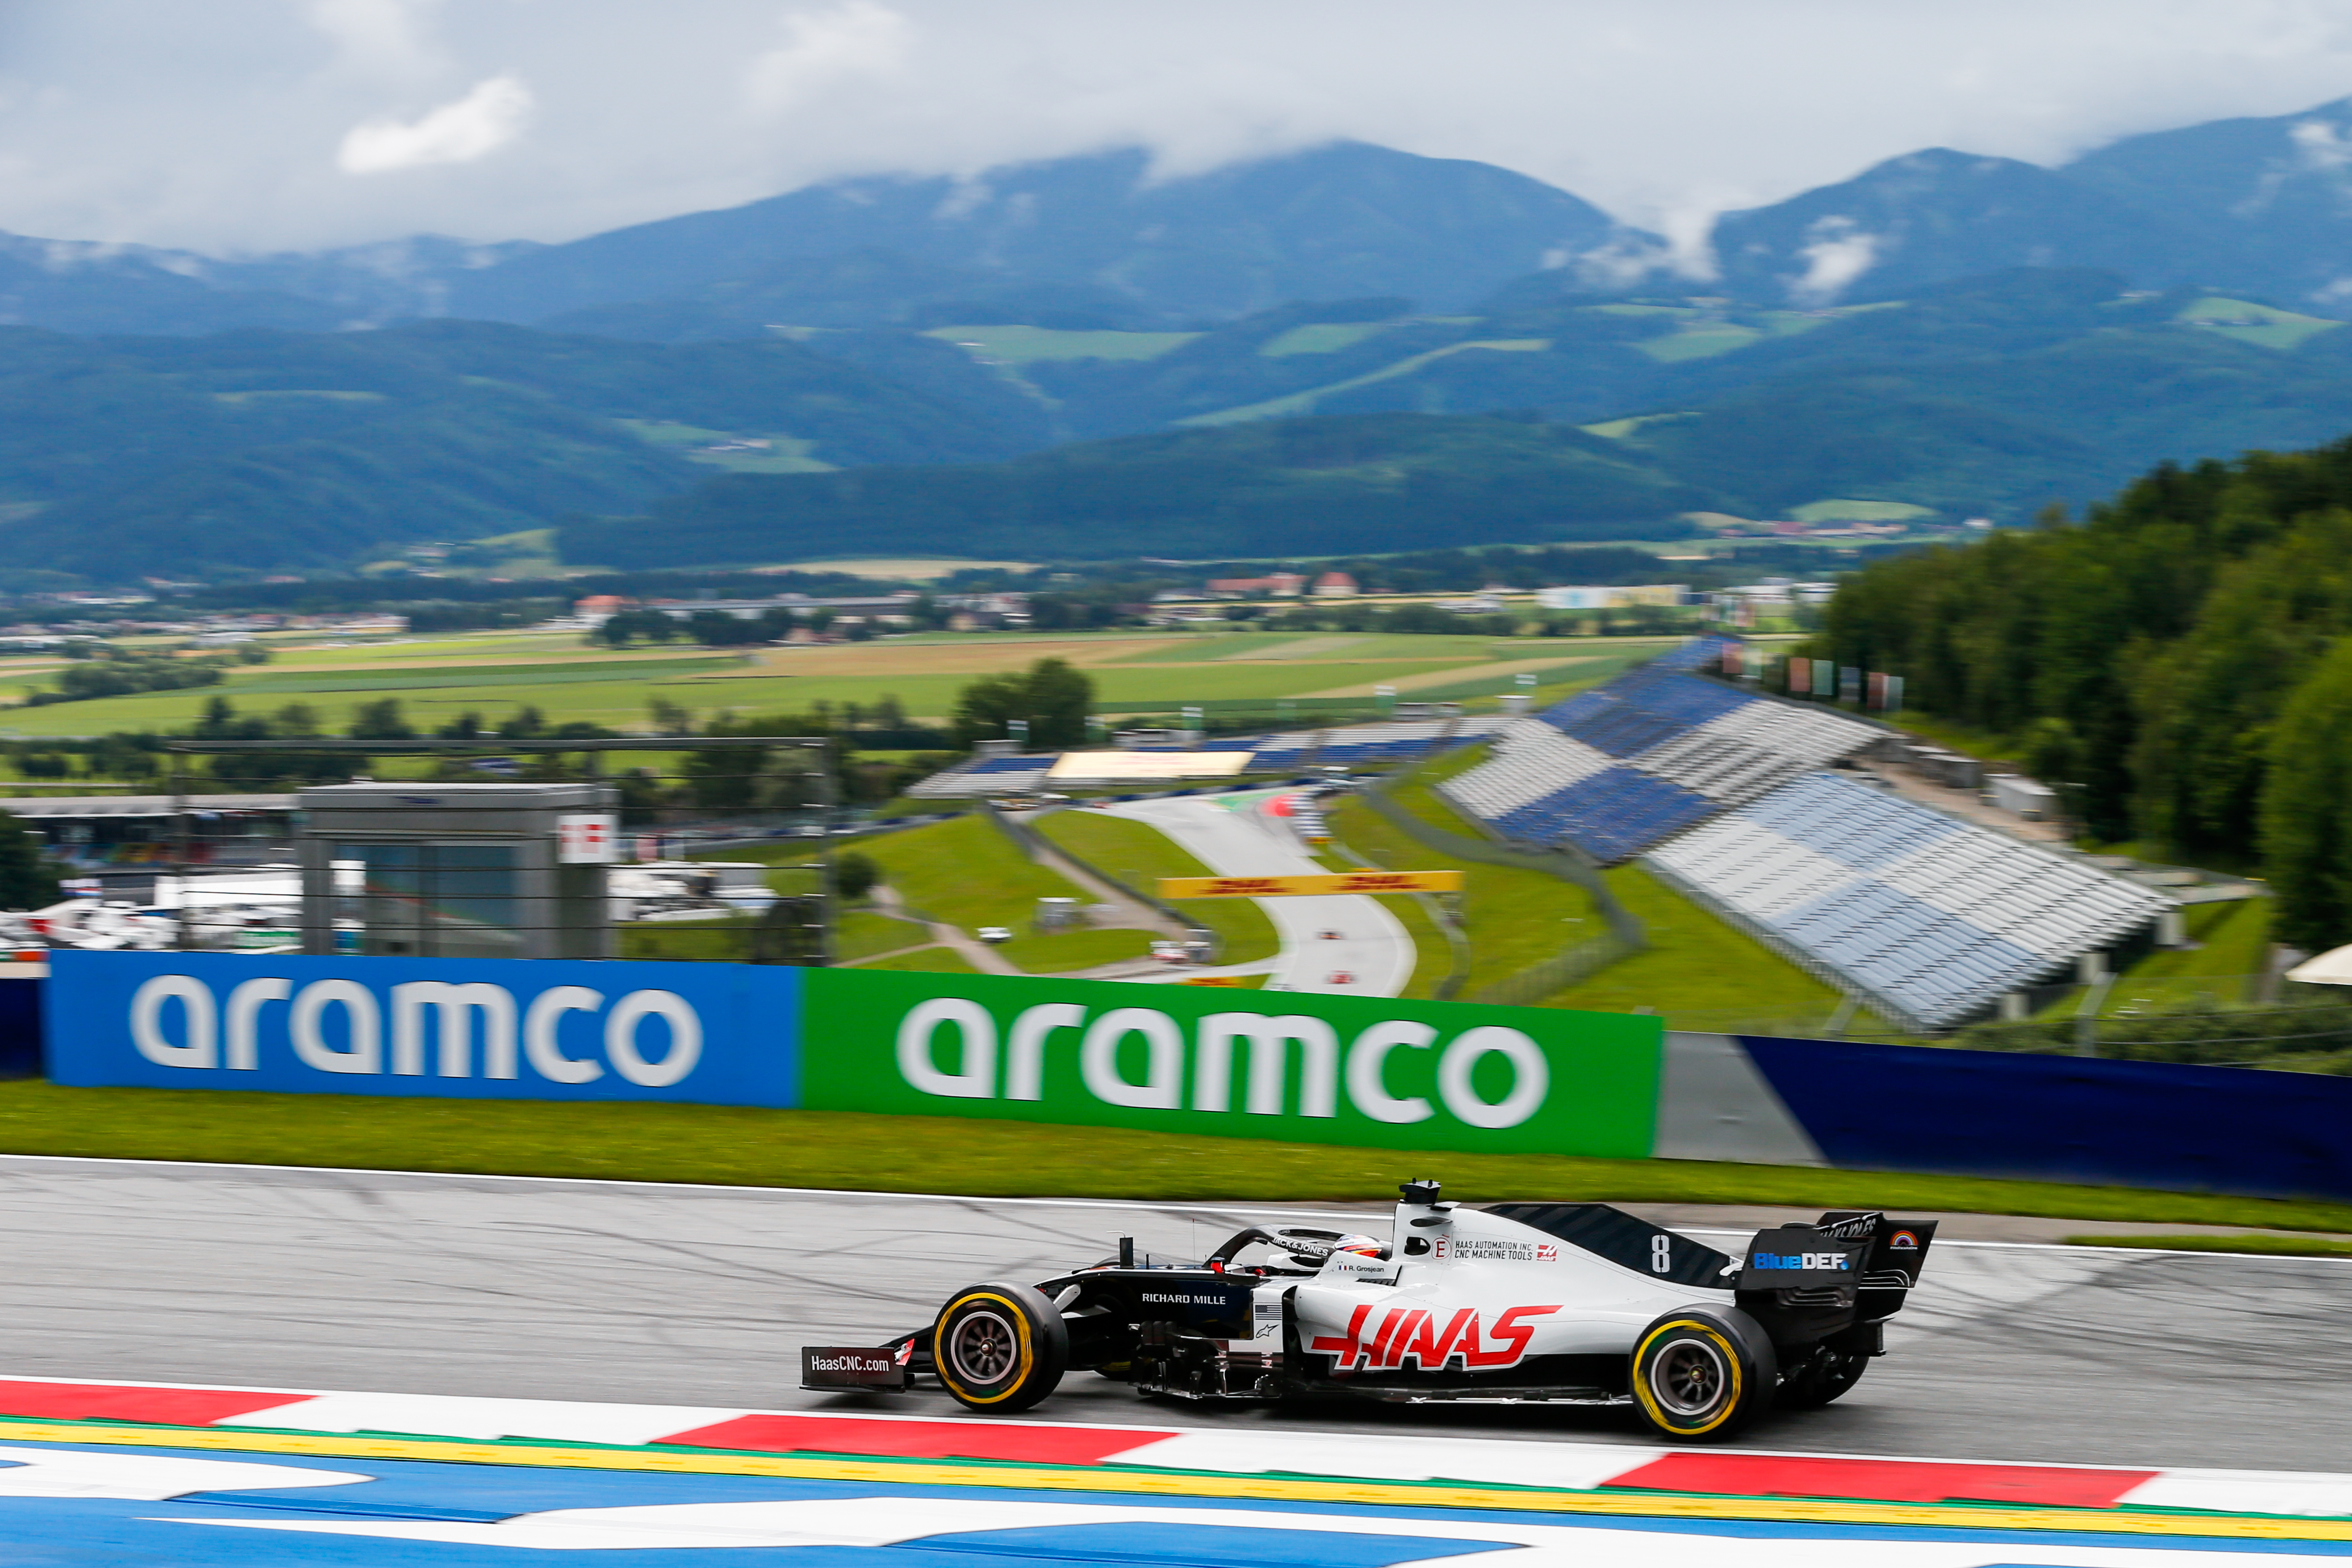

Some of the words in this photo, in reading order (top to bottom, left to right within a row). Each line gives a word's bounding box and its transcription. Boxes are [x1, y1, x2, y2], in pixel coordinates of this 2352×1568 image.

[130, 974, 703, 1087] aramco
[896, 997, 1549, 1129] aramco
[1272, 1236, 1329, 1256] JACK&JONES
[1436, 1241, 1446, 1258] E
[1455, 1241, 1472, 1249] HAAS
[1475, 1241, 1517, 1250] AUTOMATION
[1652, 1235, 1670, 1273] 8
[1454, 1250, 1469, 1259] CNC
[1471, 1250, 1506, 1259] MACHINE
[1509, 1250, 1533, 1261] TOOLS
[1754, 1253, 1848, 1270] BlueDEF
[1142, 1293, 1190, 1303] RICHARD
[1194, 1296, 1226, 1305] MILLE
[1311, 1304, 1565, 1368] HAAS
[811, 1355, 889, 1372] HaasCNC.com
